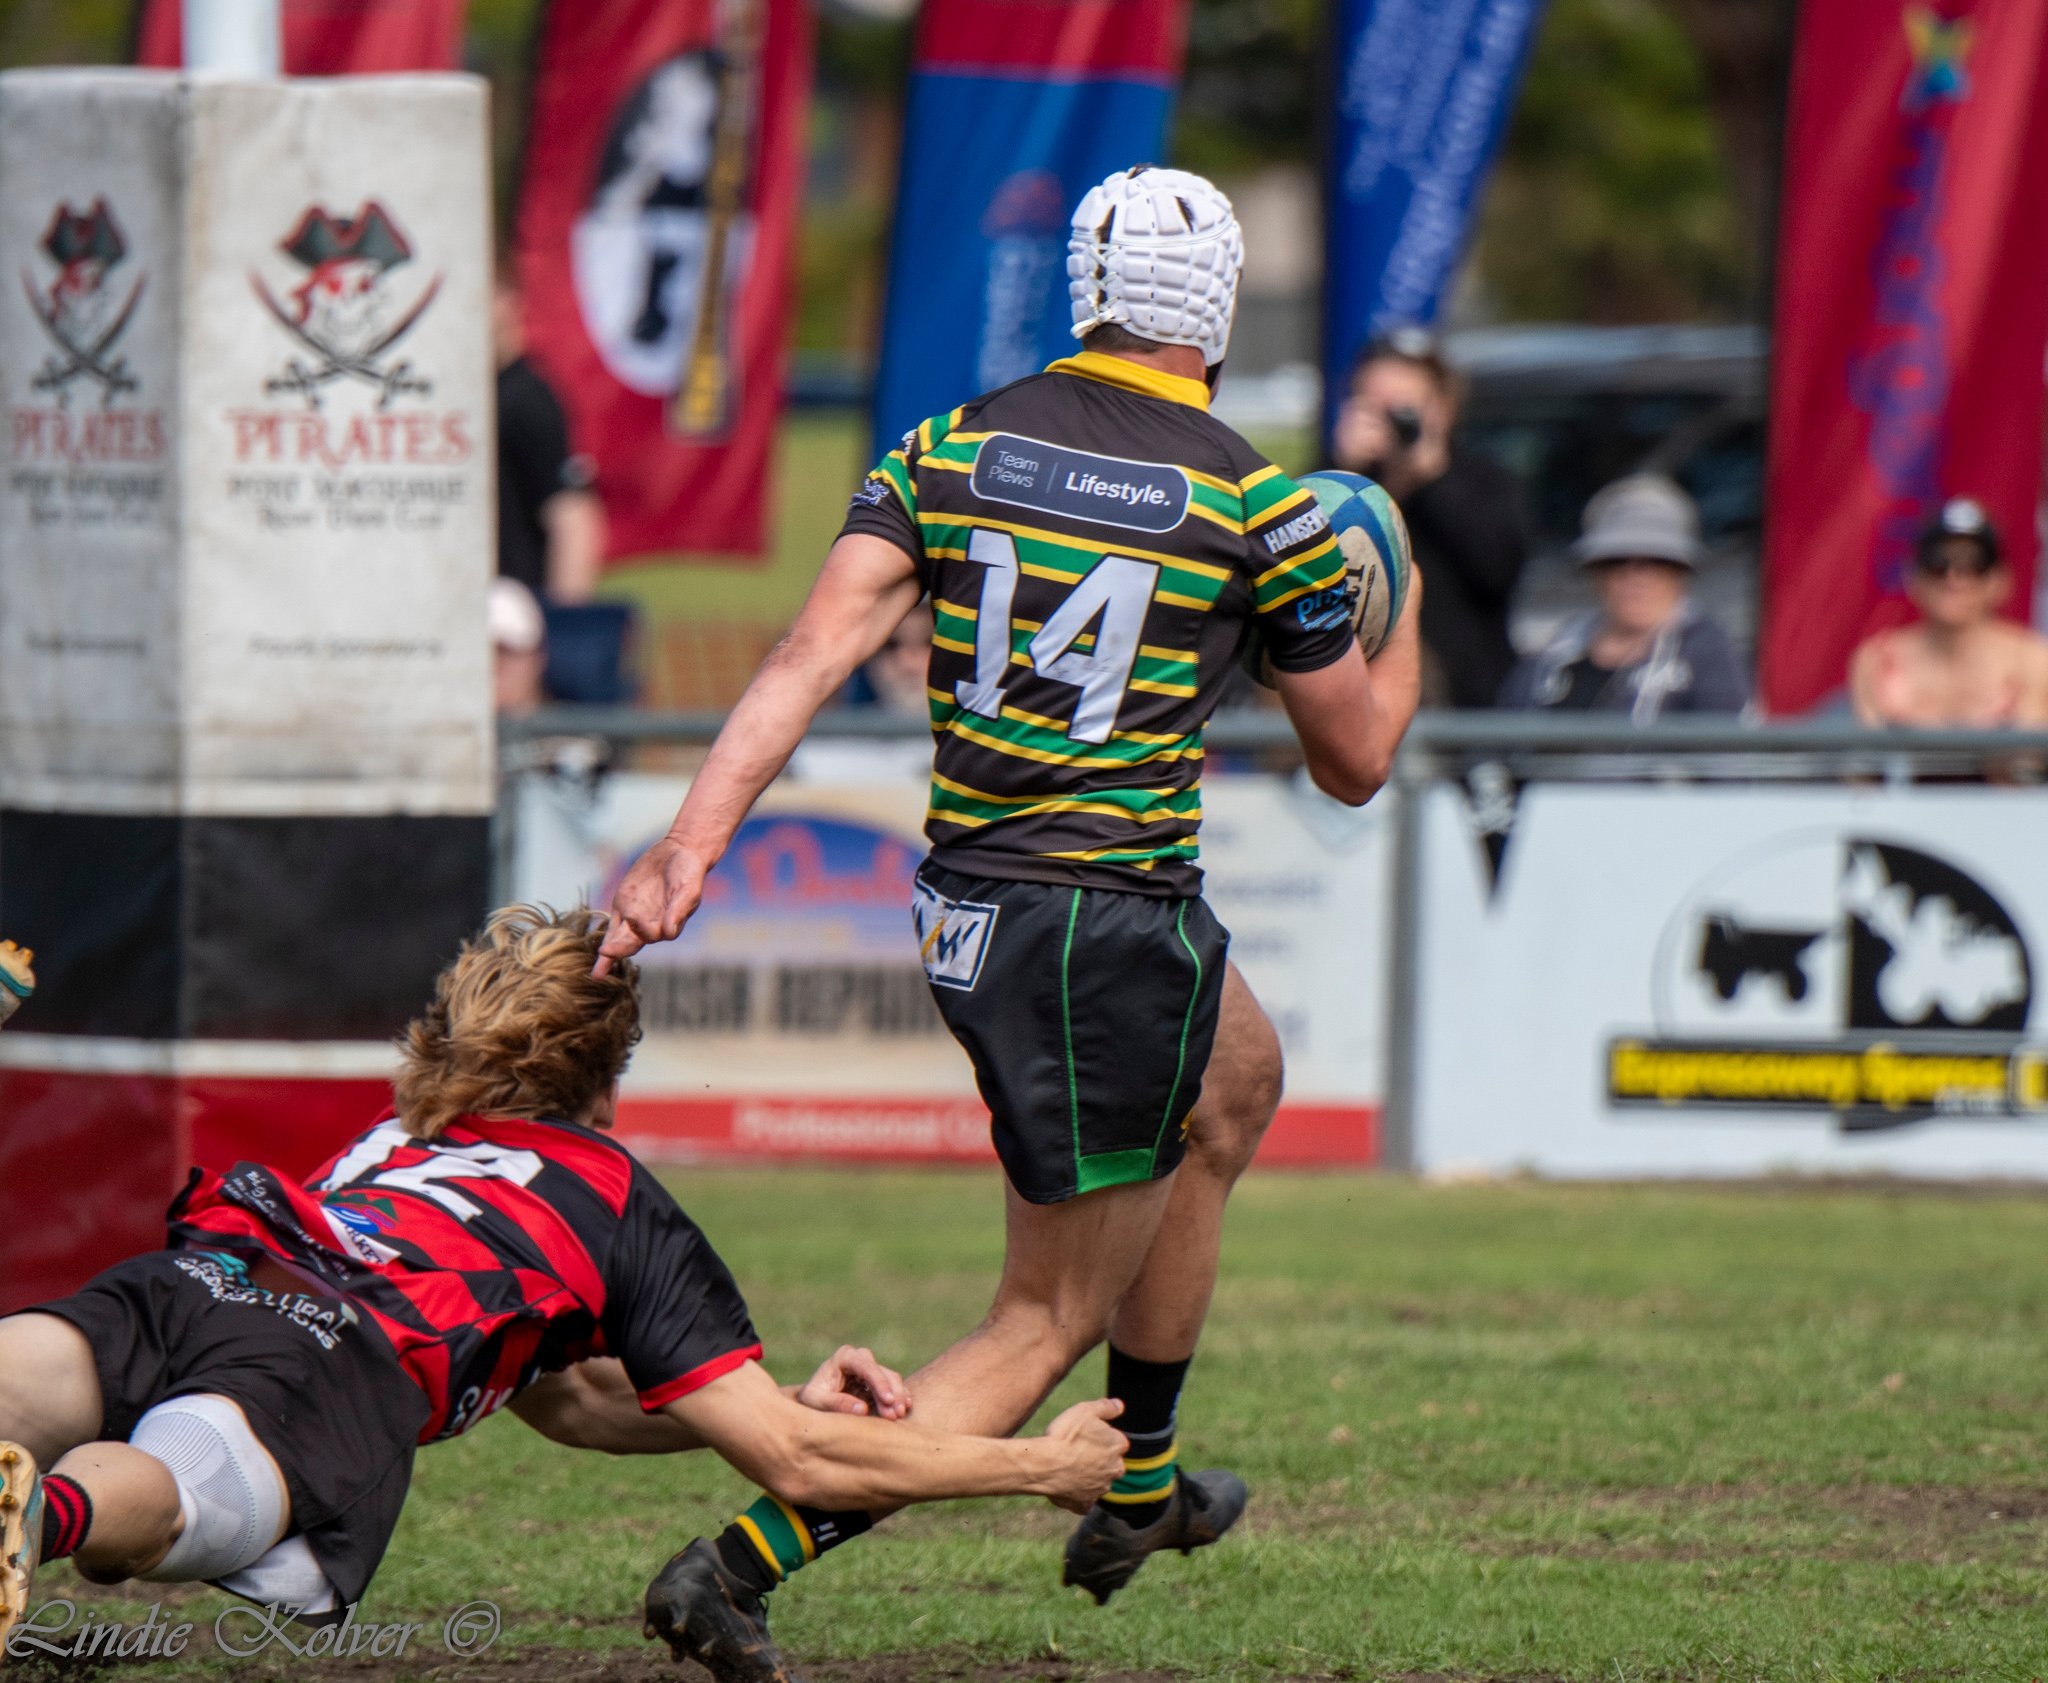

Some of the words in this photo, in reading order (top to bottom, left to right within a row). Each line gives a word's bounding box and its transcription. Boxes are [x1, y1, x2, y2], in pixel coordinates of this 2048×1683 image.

[12, 408, 168, 463] PIRATES
[224, 406, 472, 472] PIRATES
[988, 465, 1034, 488] Plews
[998, 450, 1039, 473] Team
[1065, 471, 1172, 506] Lifestyle.
[955, 527, 1160, 743] 14
